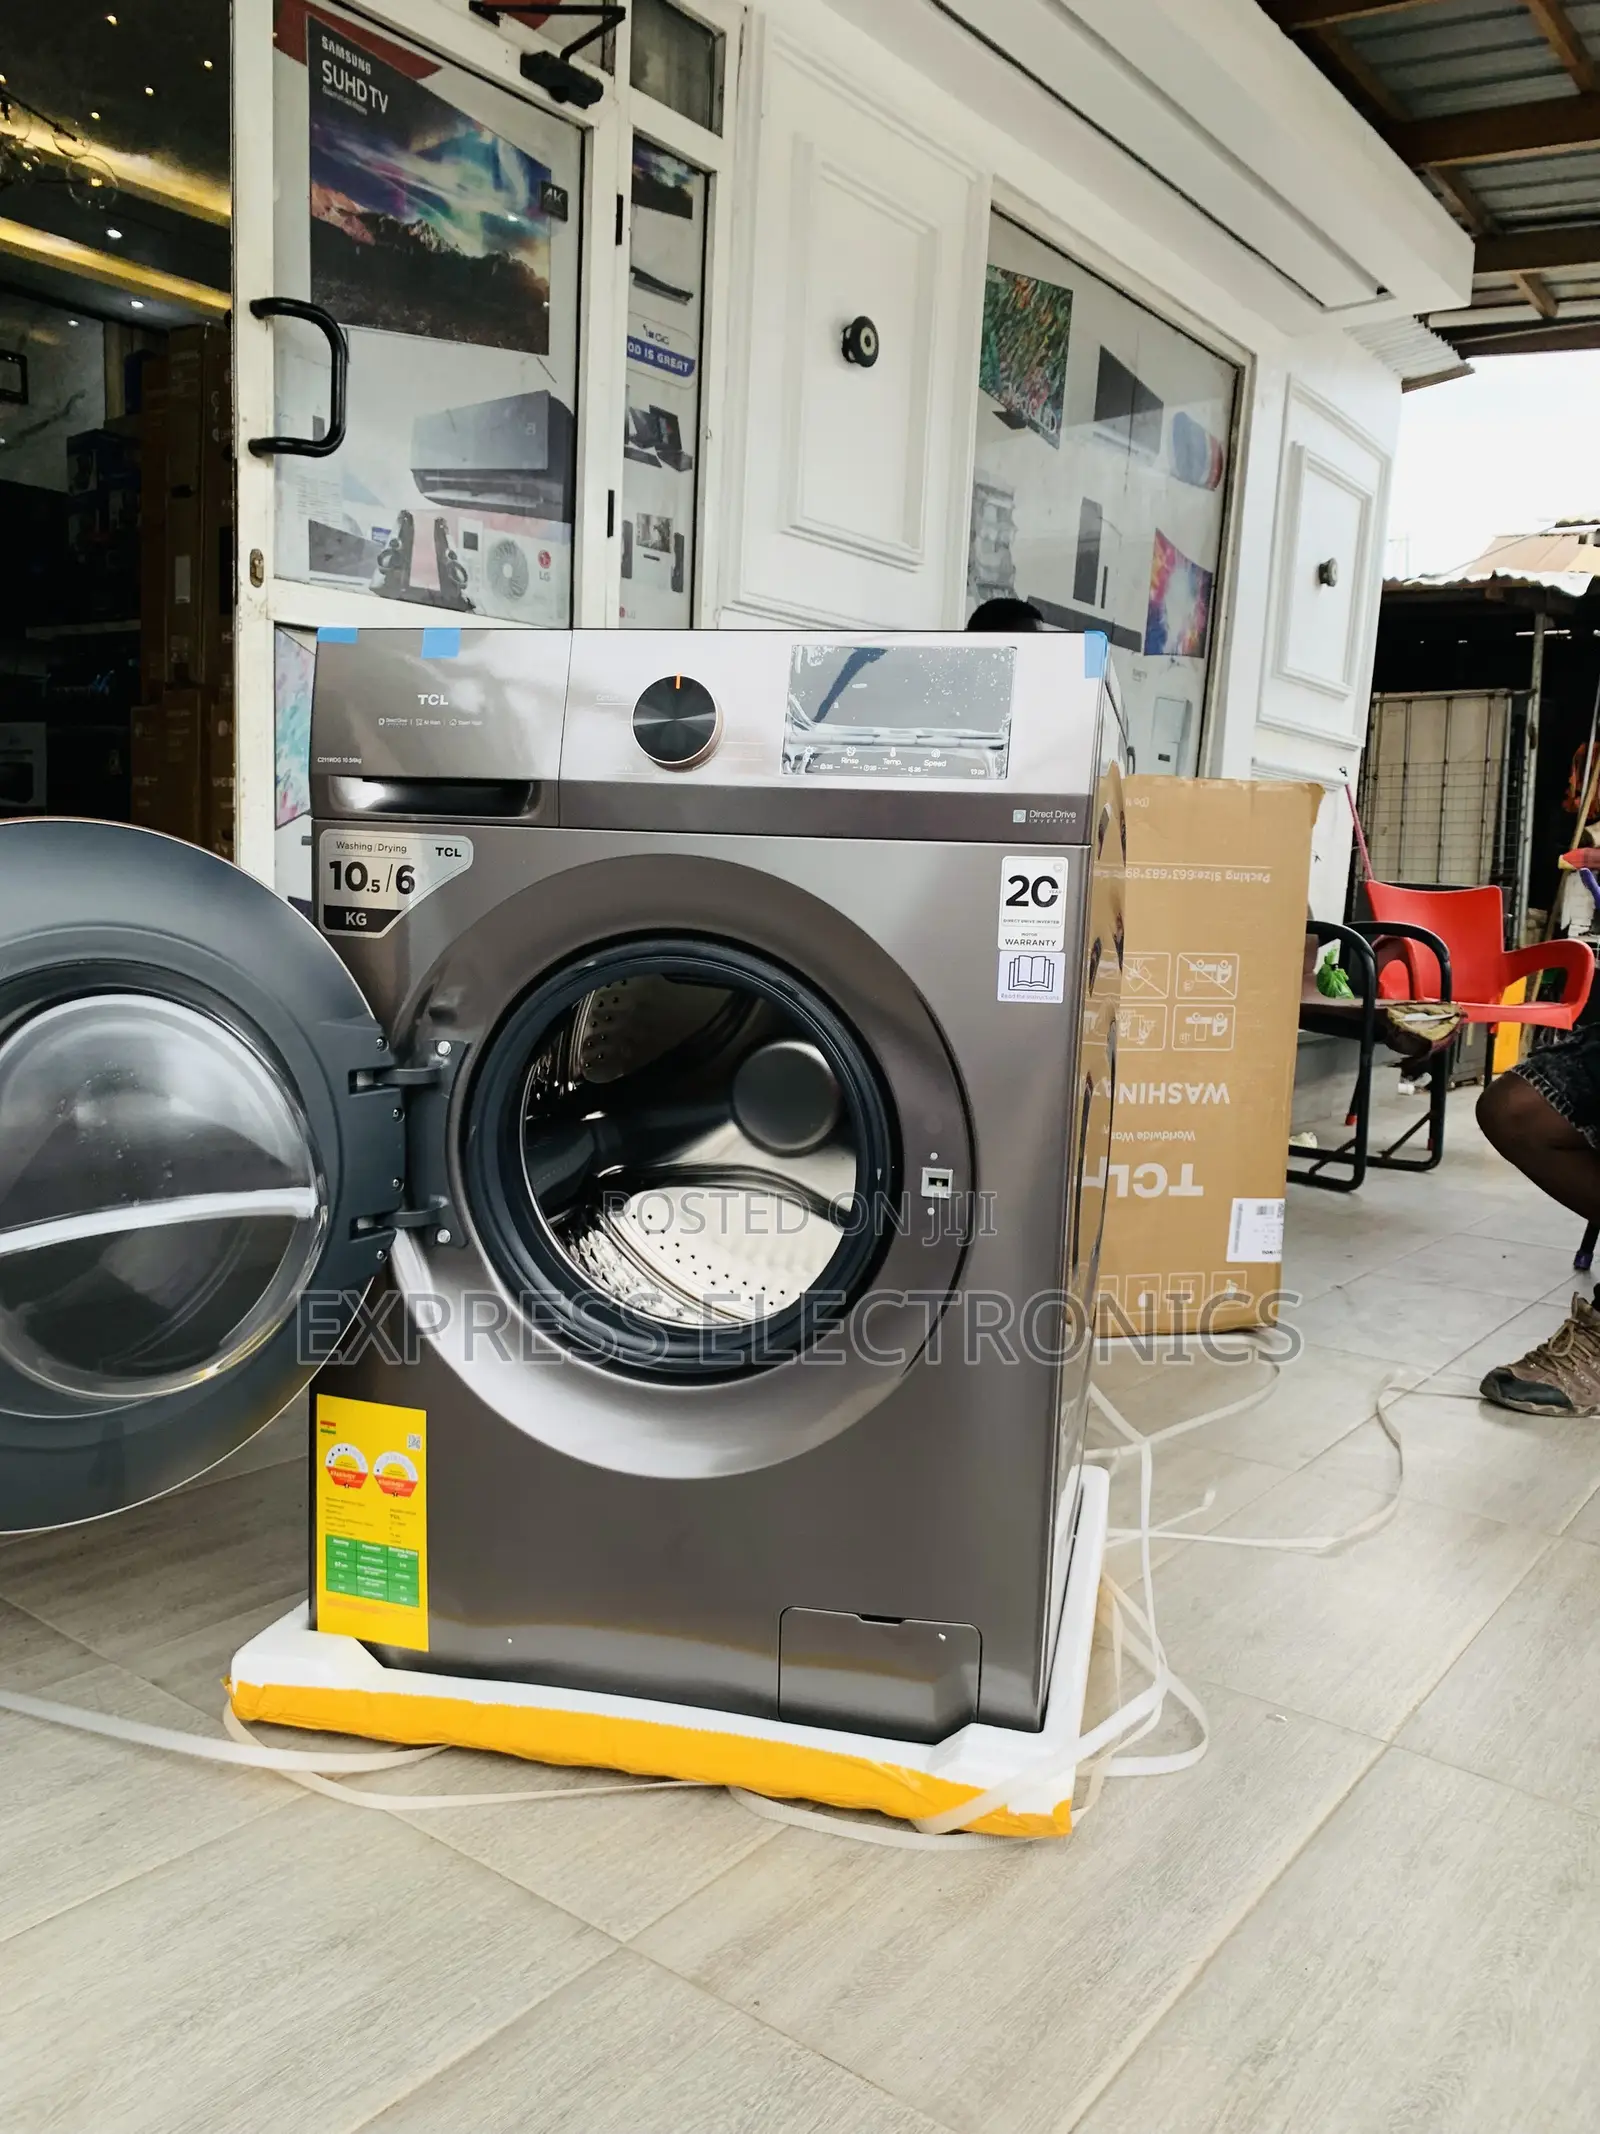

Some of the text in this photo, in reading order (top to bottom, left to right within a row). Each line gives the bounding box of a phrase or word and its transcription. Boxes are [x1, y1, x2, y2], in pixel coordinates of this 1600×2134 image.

[322, 35, 371, 75] SAMSUNG
[628, 342, 689, 373] OD IS GREAT
[417, 694, 449, 706] TCL
[840, 757, 860, 765] Rinse
[924, 759, 947, 768] Speed
[1029, 810, 1077, 818] Direct Drive
[435, 847, 462, 858] TCL
[1226, 872, 1271, 884] Packing
[346, 912, 368, 926] KG
[1004, 938, 1057, 947] WARRANTY
[1115, 1082, 1230, 1104] WASHIN
[1136, 1130, 1196, 1142] Worldwide
[1108, 1162, 1204, 1198] TCL
